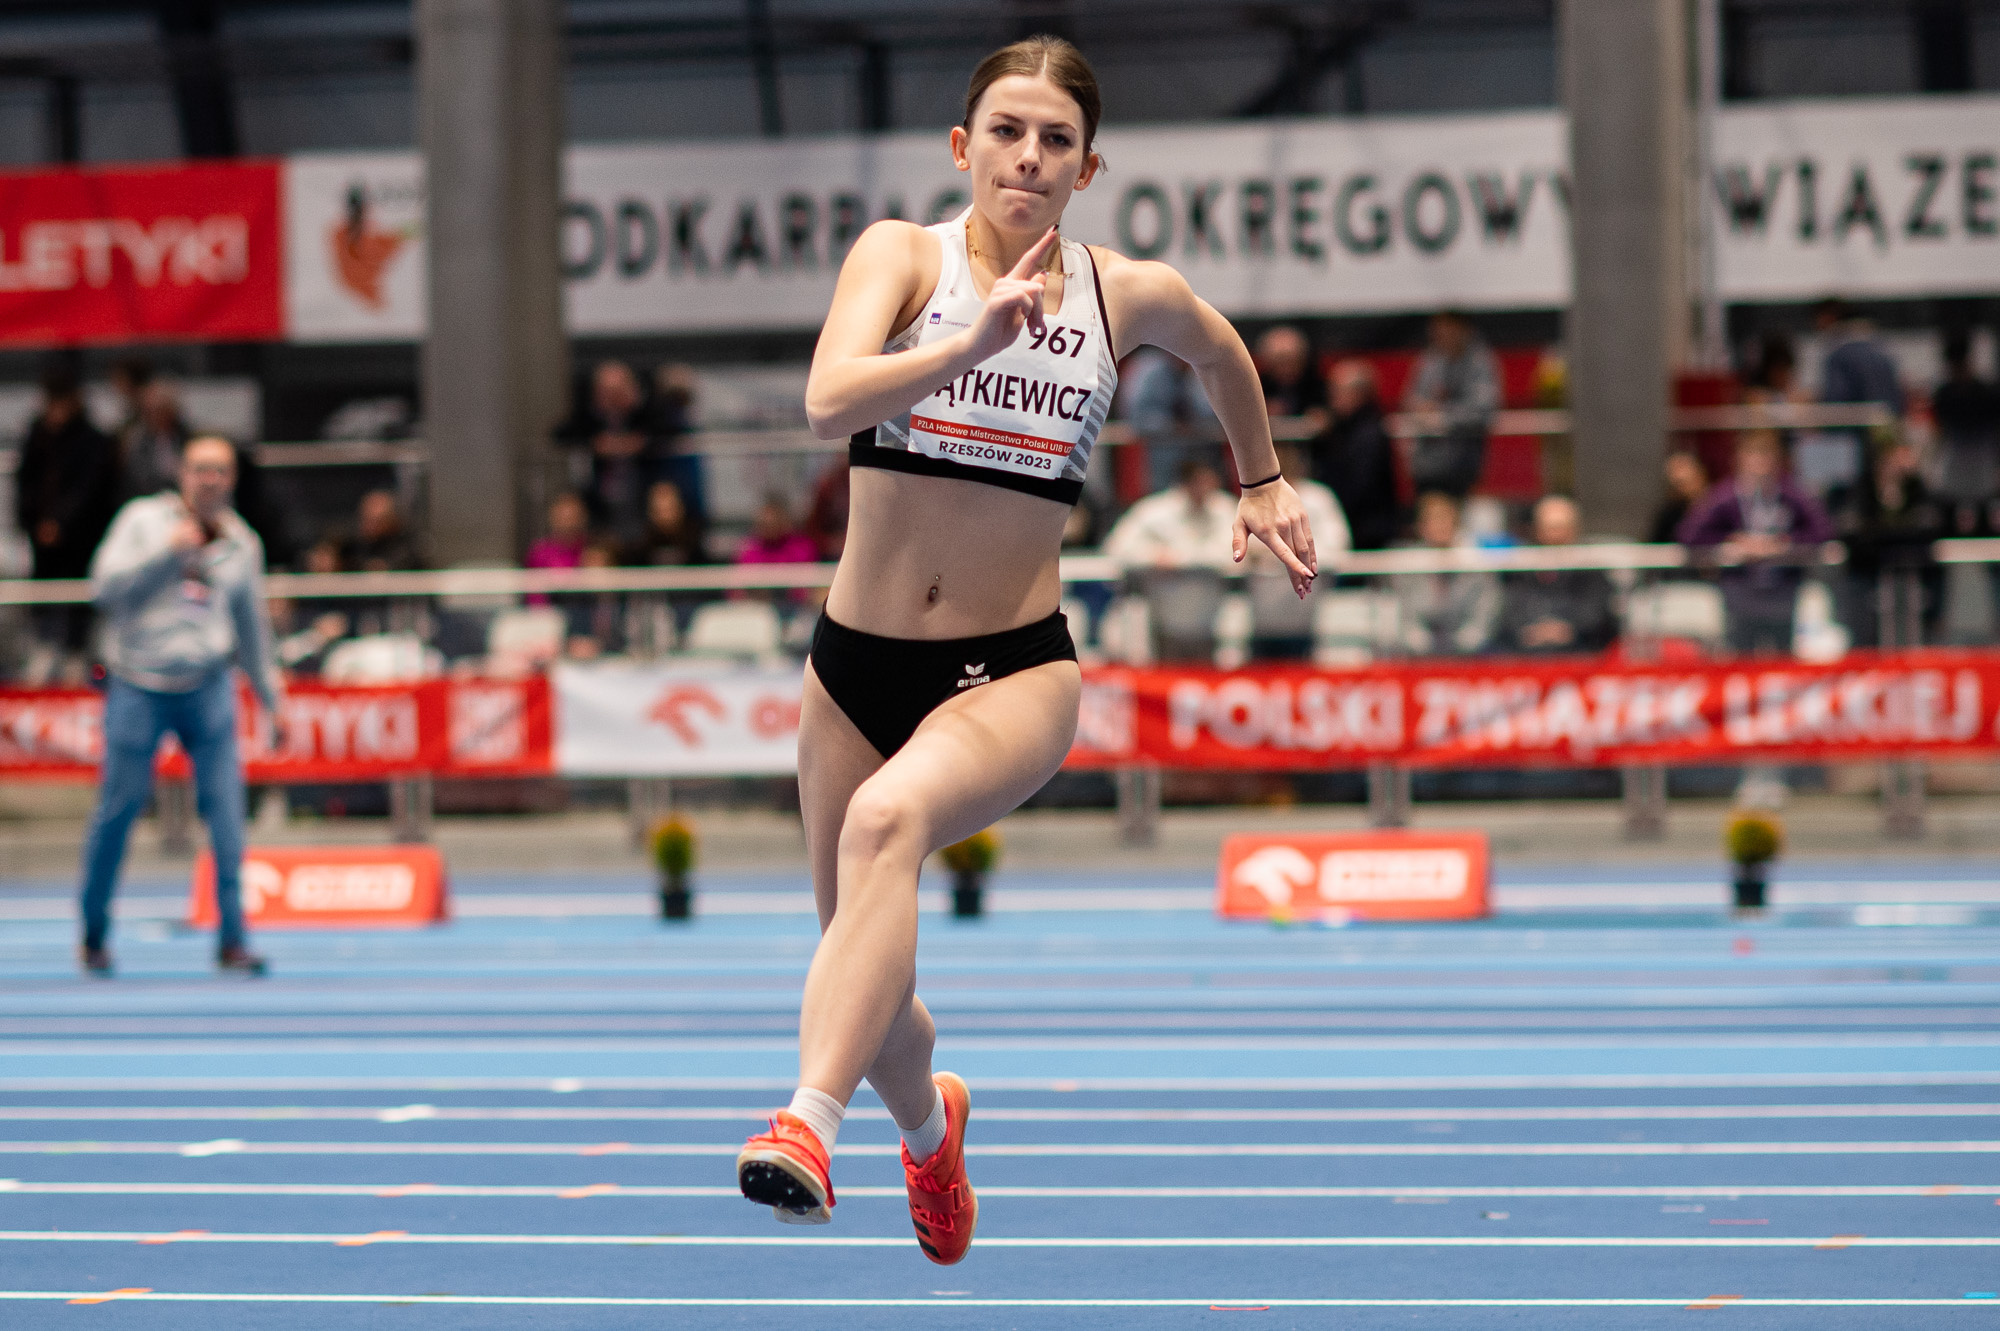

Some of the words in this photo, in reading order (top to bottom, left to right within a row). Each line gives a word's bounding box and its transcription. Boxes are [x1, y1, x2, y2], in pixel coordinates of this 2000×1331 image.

[1027, 326, 1086, 358] 967
[917, 419, 934, 430] PZLA
[936, 424, 968, 436] Halowe
[969, 429, 1022, 445] Mistrzostwa
[1023, 438, 1048, 450] Polski
[1049, 443, 1063, 453] U18
[939, 440, 1012, 462] RZESZÓW
[1014, 453, 1052, 470] 2023
[957, 675, 990, 688] erima
[1167, 678, 1405, 751] POLSKI
